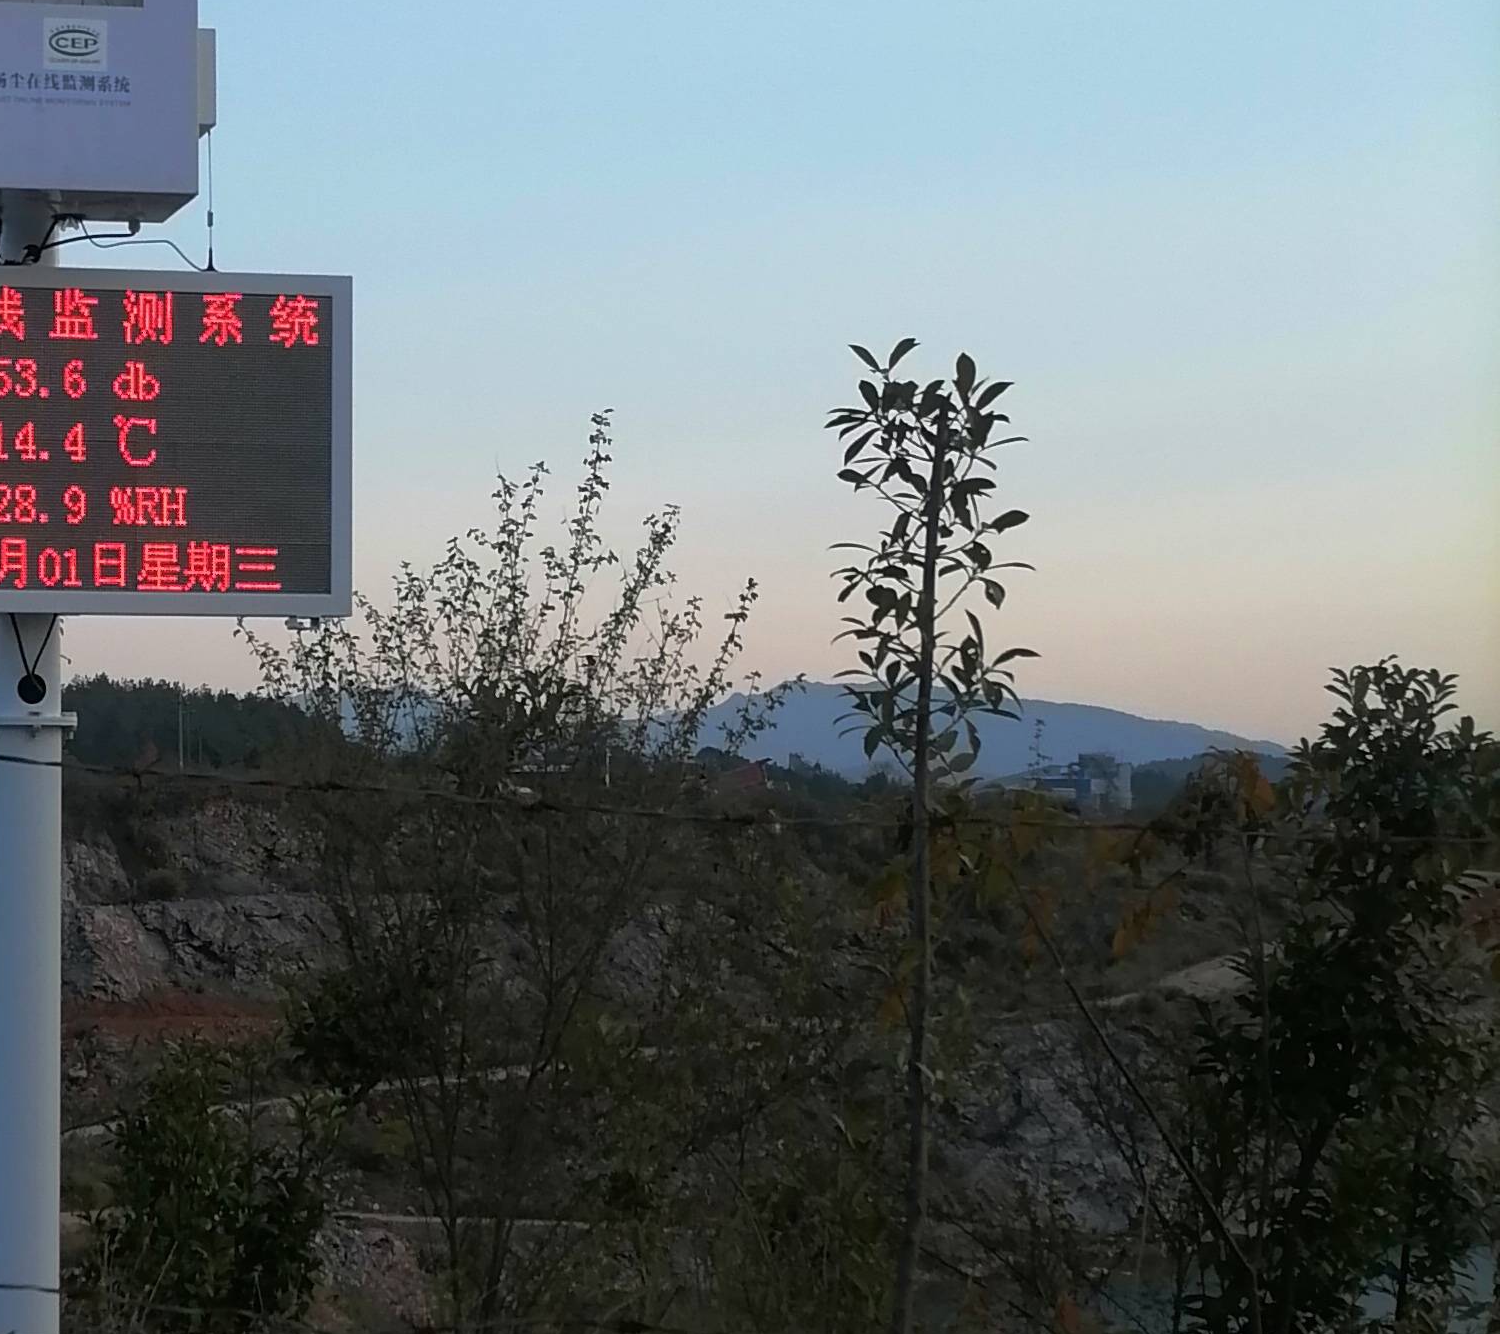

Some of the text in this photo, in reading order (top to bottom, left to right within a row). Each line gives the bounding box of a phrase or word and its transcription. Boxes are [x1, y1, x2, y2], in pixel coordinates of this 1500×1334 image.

[55, 37, 98, 49] CEP
[112, 360, 161, 402] db
[109, 486, 188, 527] %RH
